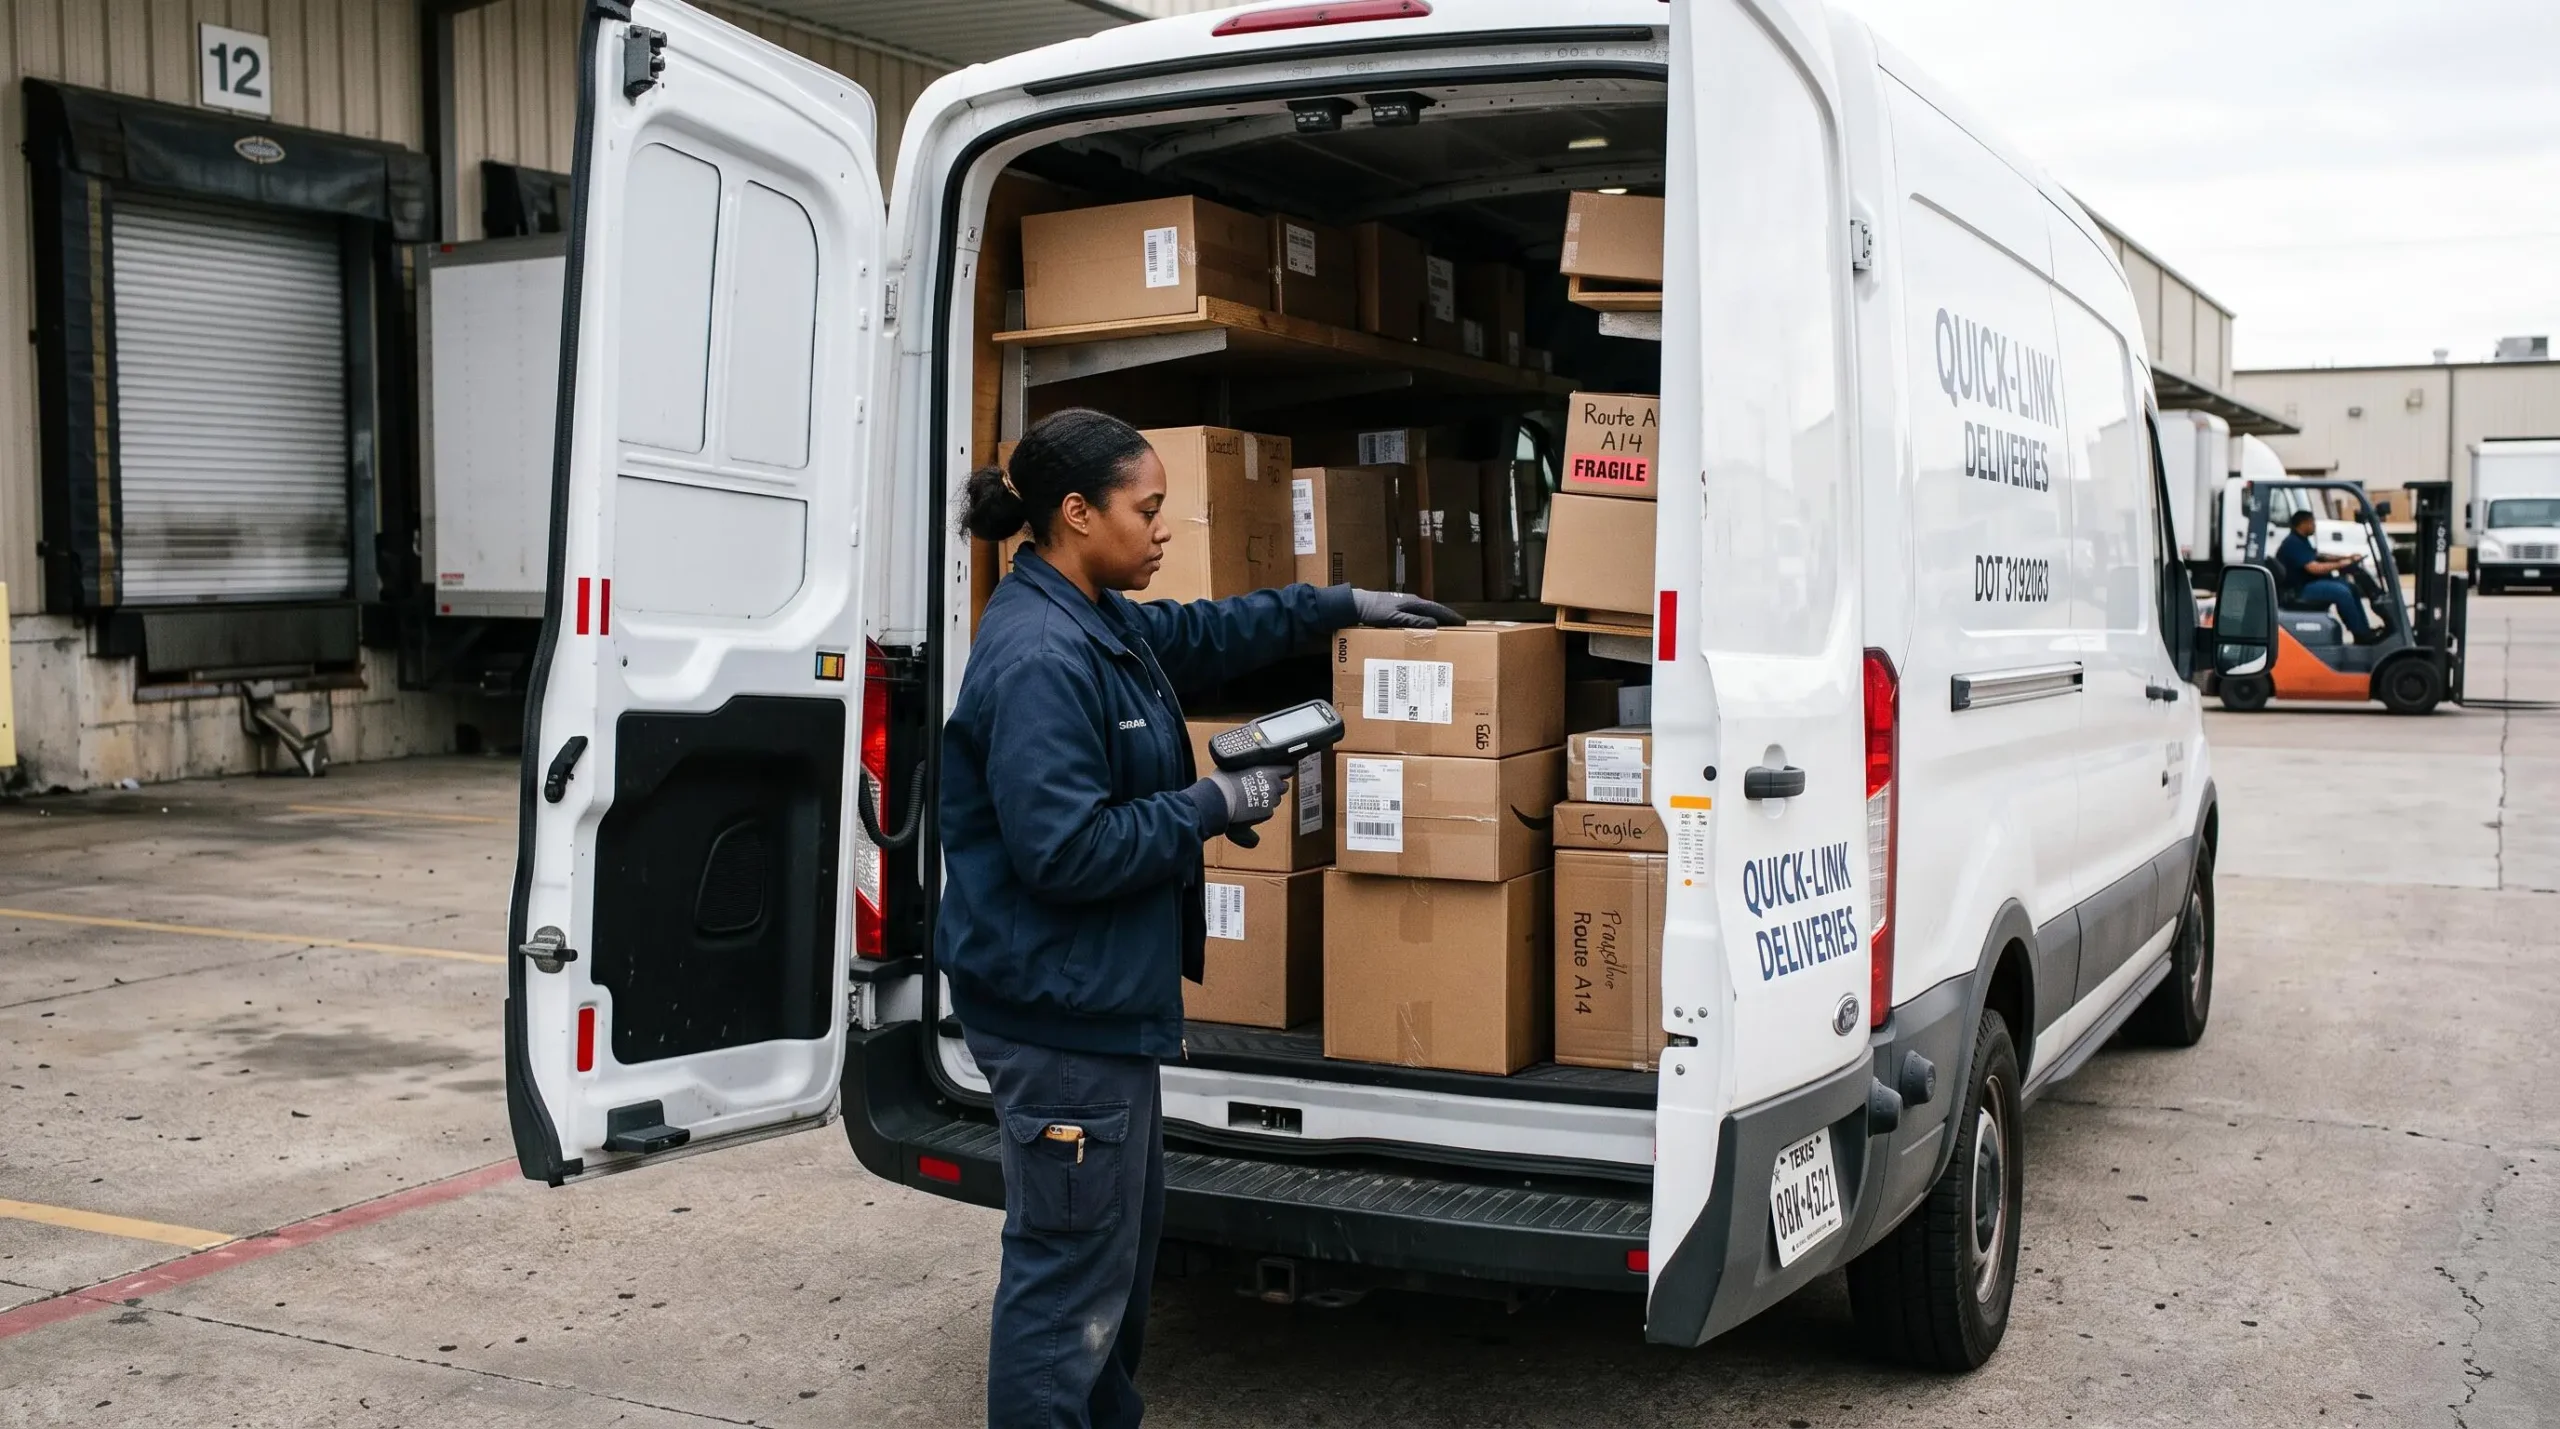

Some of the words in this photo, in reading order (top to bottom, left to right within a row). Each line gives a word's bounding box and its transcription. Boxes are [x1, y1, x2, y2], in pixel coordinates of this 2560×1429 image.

[209, 42, 262, 98] 12
[1935, 307, 2059, 429] QUICK-LINK
[1584, 403, 1635, 427] Route
[1600, 430, 1643, 453] A14
[1964, 420, 2050, 492] DELIVERIES
[1574, 458, 1647, 482] FRAGILE
[1975, 554, 2003, 602] DOT
[2005, 556, 2049, 602] 3192083
[1582, 813, 1644, 846] Fragile
[1743, 841, 1852, 919] QUICK-LINK
[1573, 911, 1592, 967] Route
[1756, 905, 1858, 982] DELIVERIES
[1574, 974, 1593, 1014] A14
